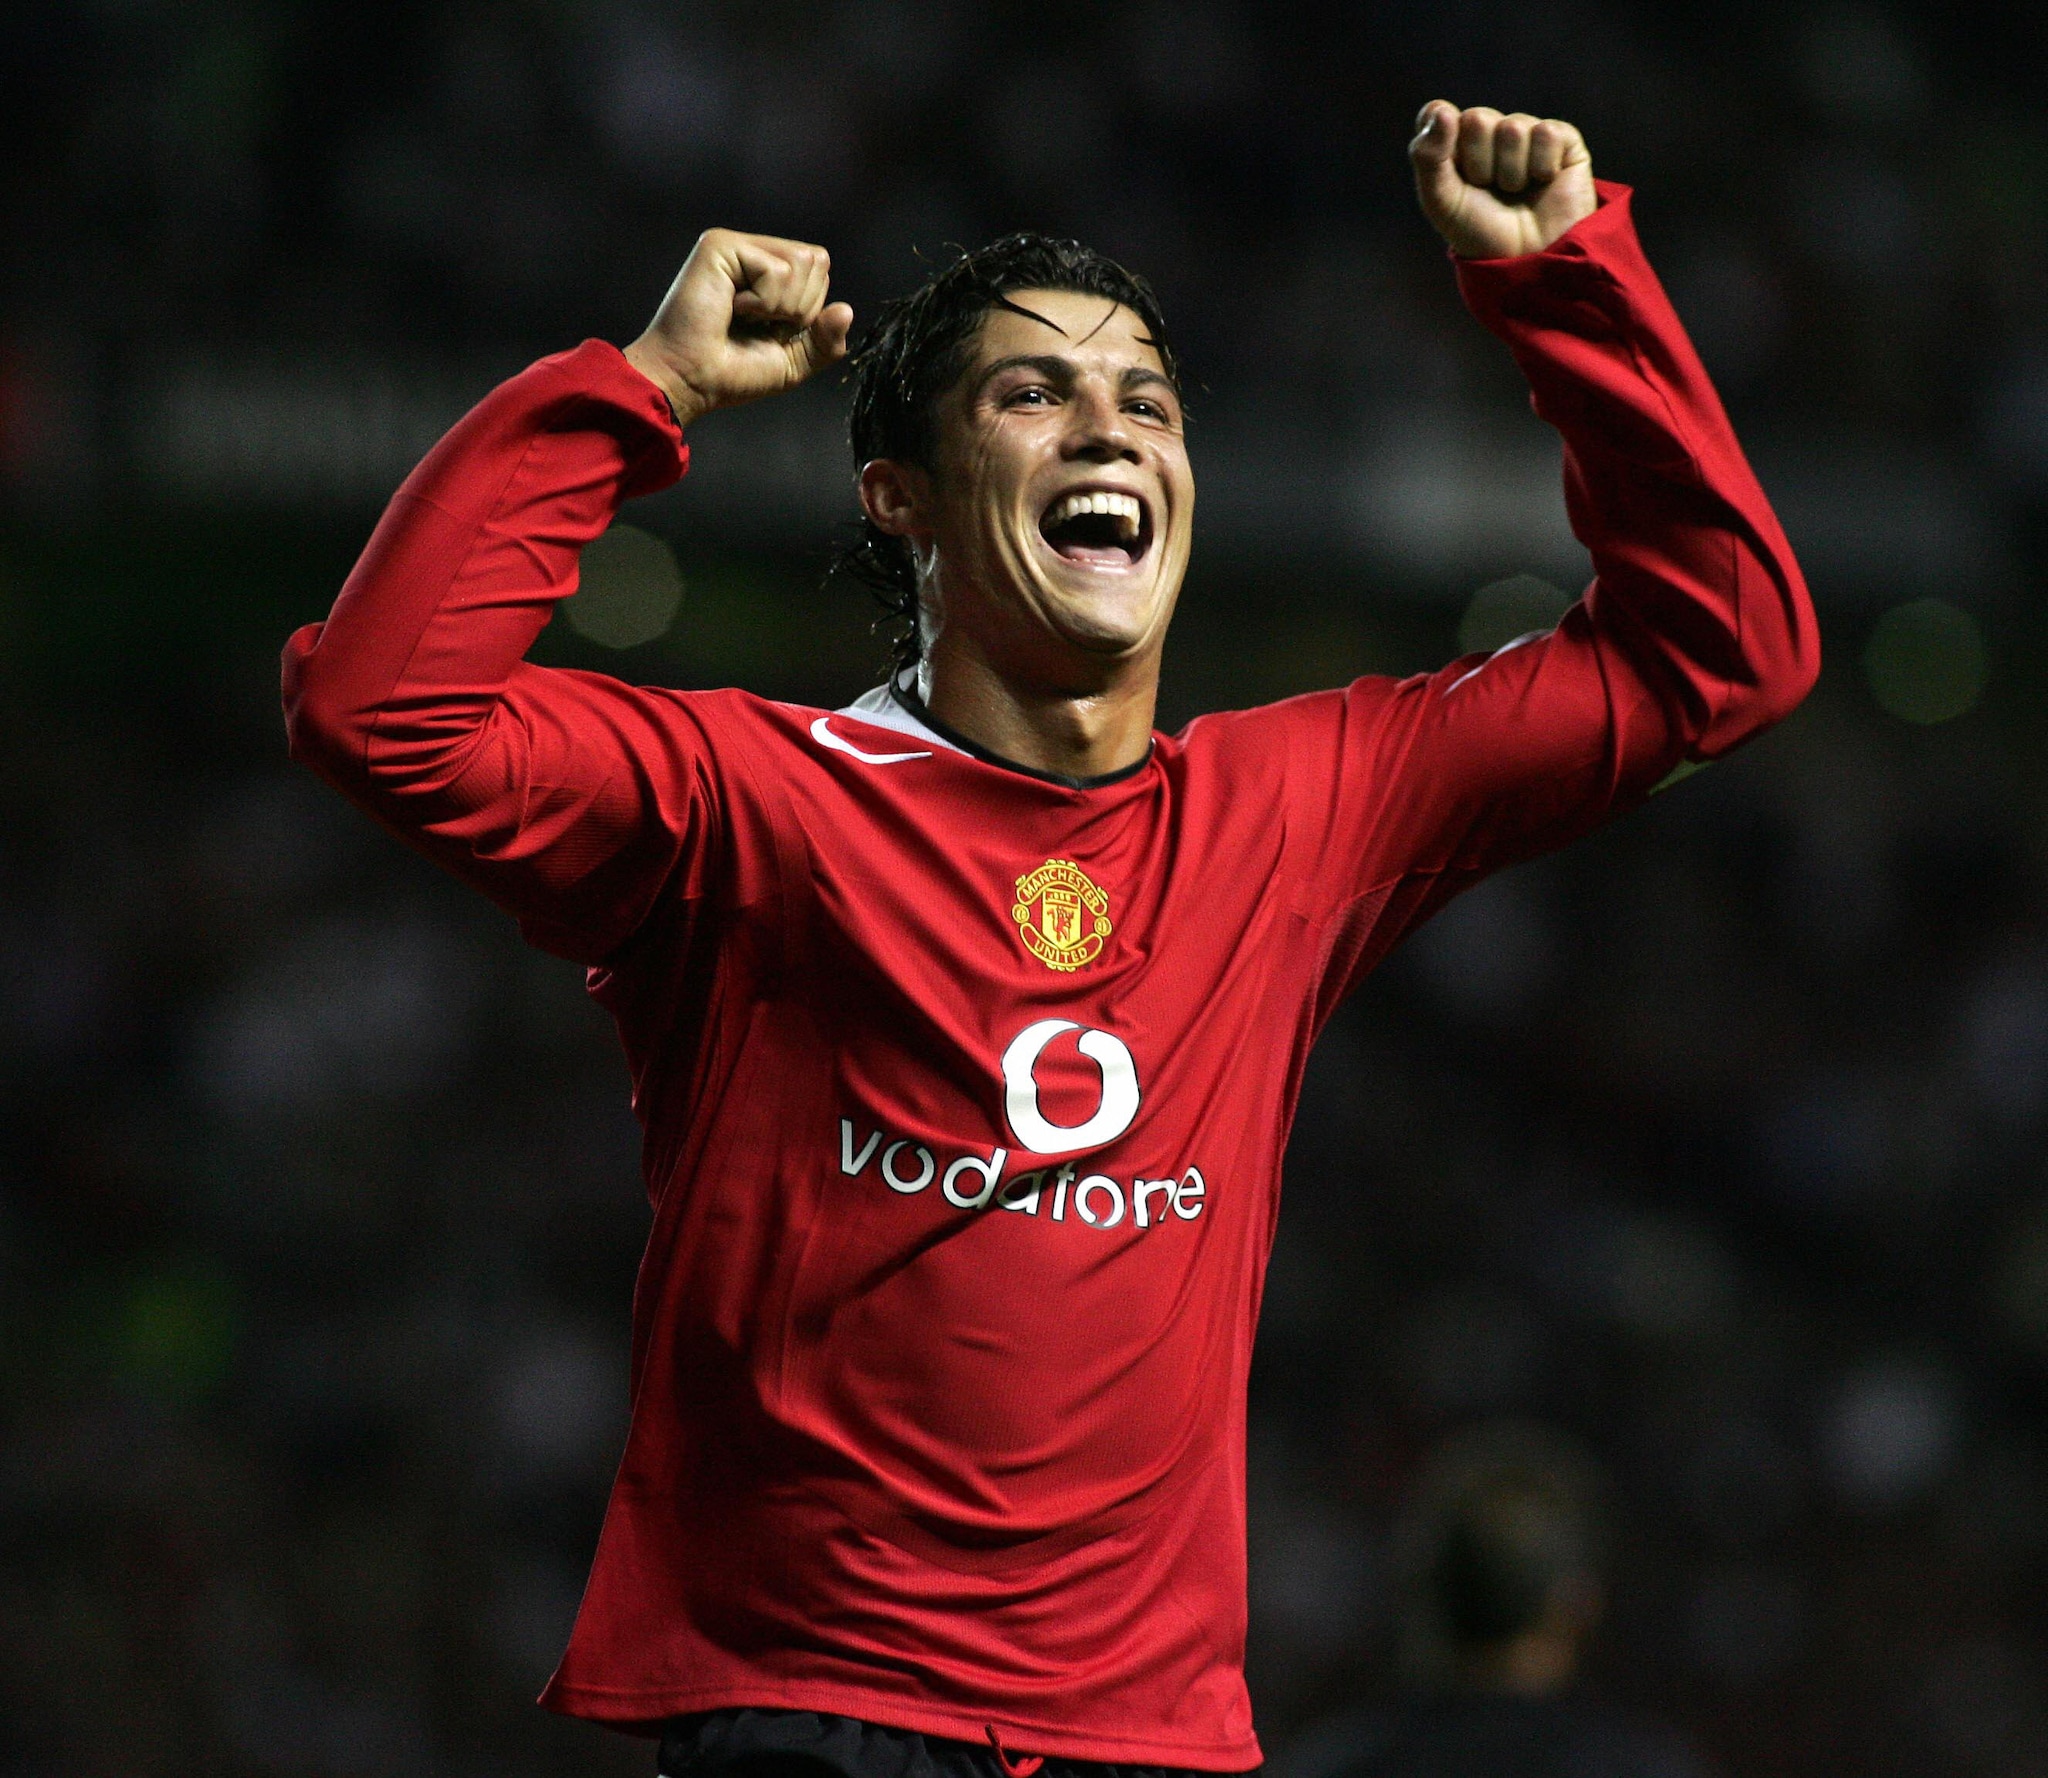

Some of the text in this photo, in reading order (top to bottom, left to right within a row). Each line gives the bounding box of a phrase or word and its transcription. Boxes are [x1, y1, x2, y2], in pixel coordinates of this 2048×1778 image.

[1022, 868, 1100, 910] MANCHESTER
[1033, 939, 1088, 964] UNITED
[840, 1117, 1205, 1229] vodafone
